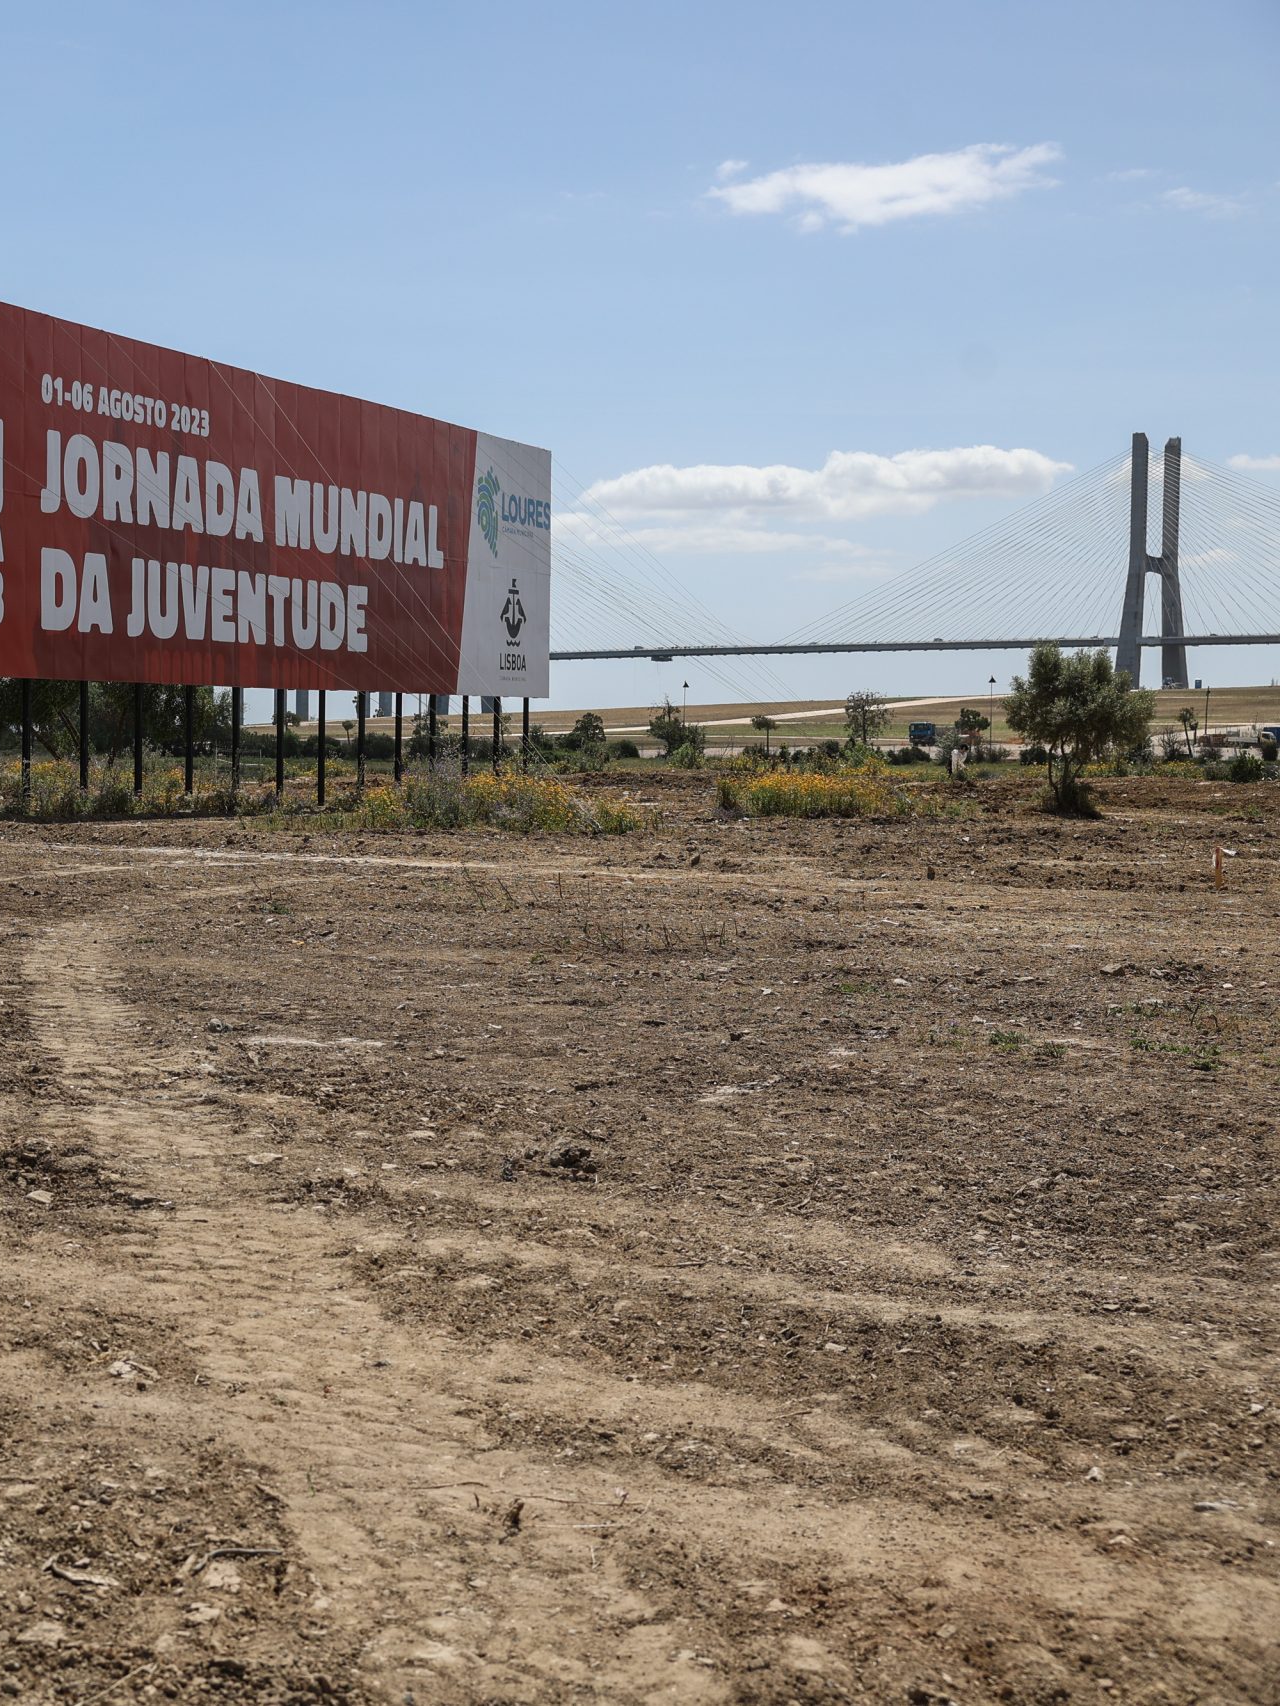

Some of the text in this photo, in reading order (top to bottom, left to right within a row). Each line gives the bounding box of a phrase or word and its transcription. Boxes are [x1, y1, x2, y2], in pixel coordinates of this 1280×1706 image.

[41, 373, 210, 438] 01-06 AGOSTO 2023
[40, 429, 444, 569] JORNADA MUNDIAL
[501, 492, 551, 530] LOURES
[40, 547, 369, 652] DA JUVENTUDE
[499, 652, 527, 671] LISBOA
